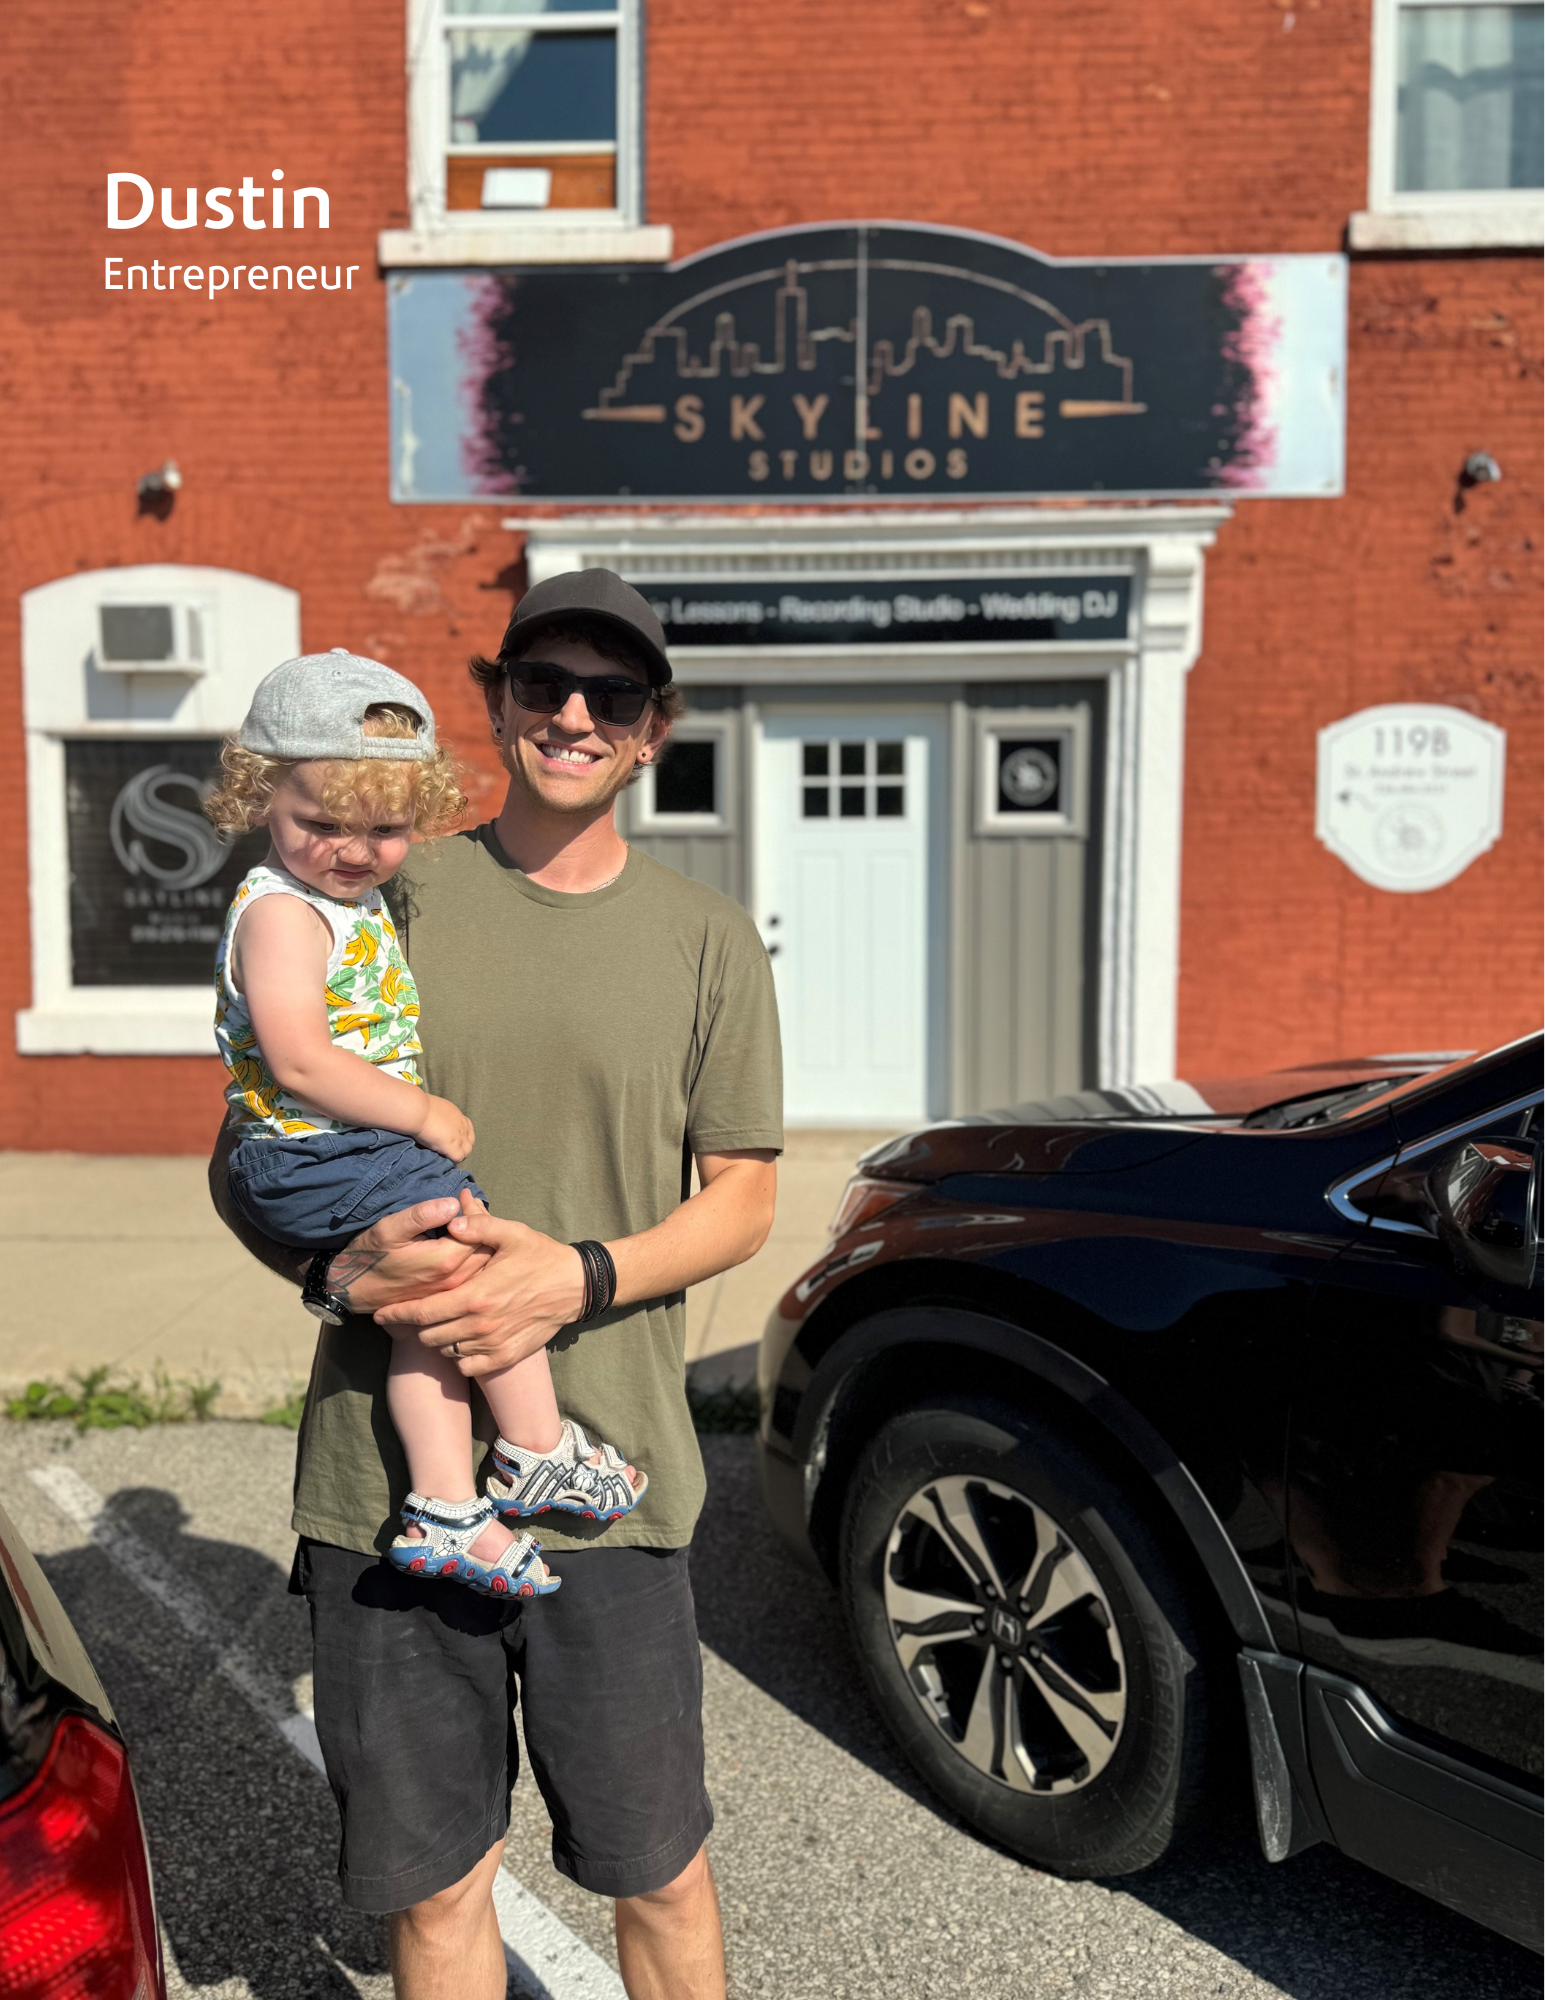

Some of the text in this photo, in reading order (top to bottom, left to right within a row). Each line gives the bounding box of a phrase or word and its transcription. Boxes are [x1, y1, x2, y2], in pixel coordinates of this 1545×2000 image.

[674, 391, 1045, 442] SKYLINE
[748, 448, 968, 481] STUDIOS
[671, 597, 764, 625] Lessons
[779, 595, 892, 628] Recording
[893, 594, 966, 622] Studio
[979, 592, 1081, 624] Wedding
[1082, 590, 1119, 618] DJ
[1374, 725, 1451, 757] 119B
